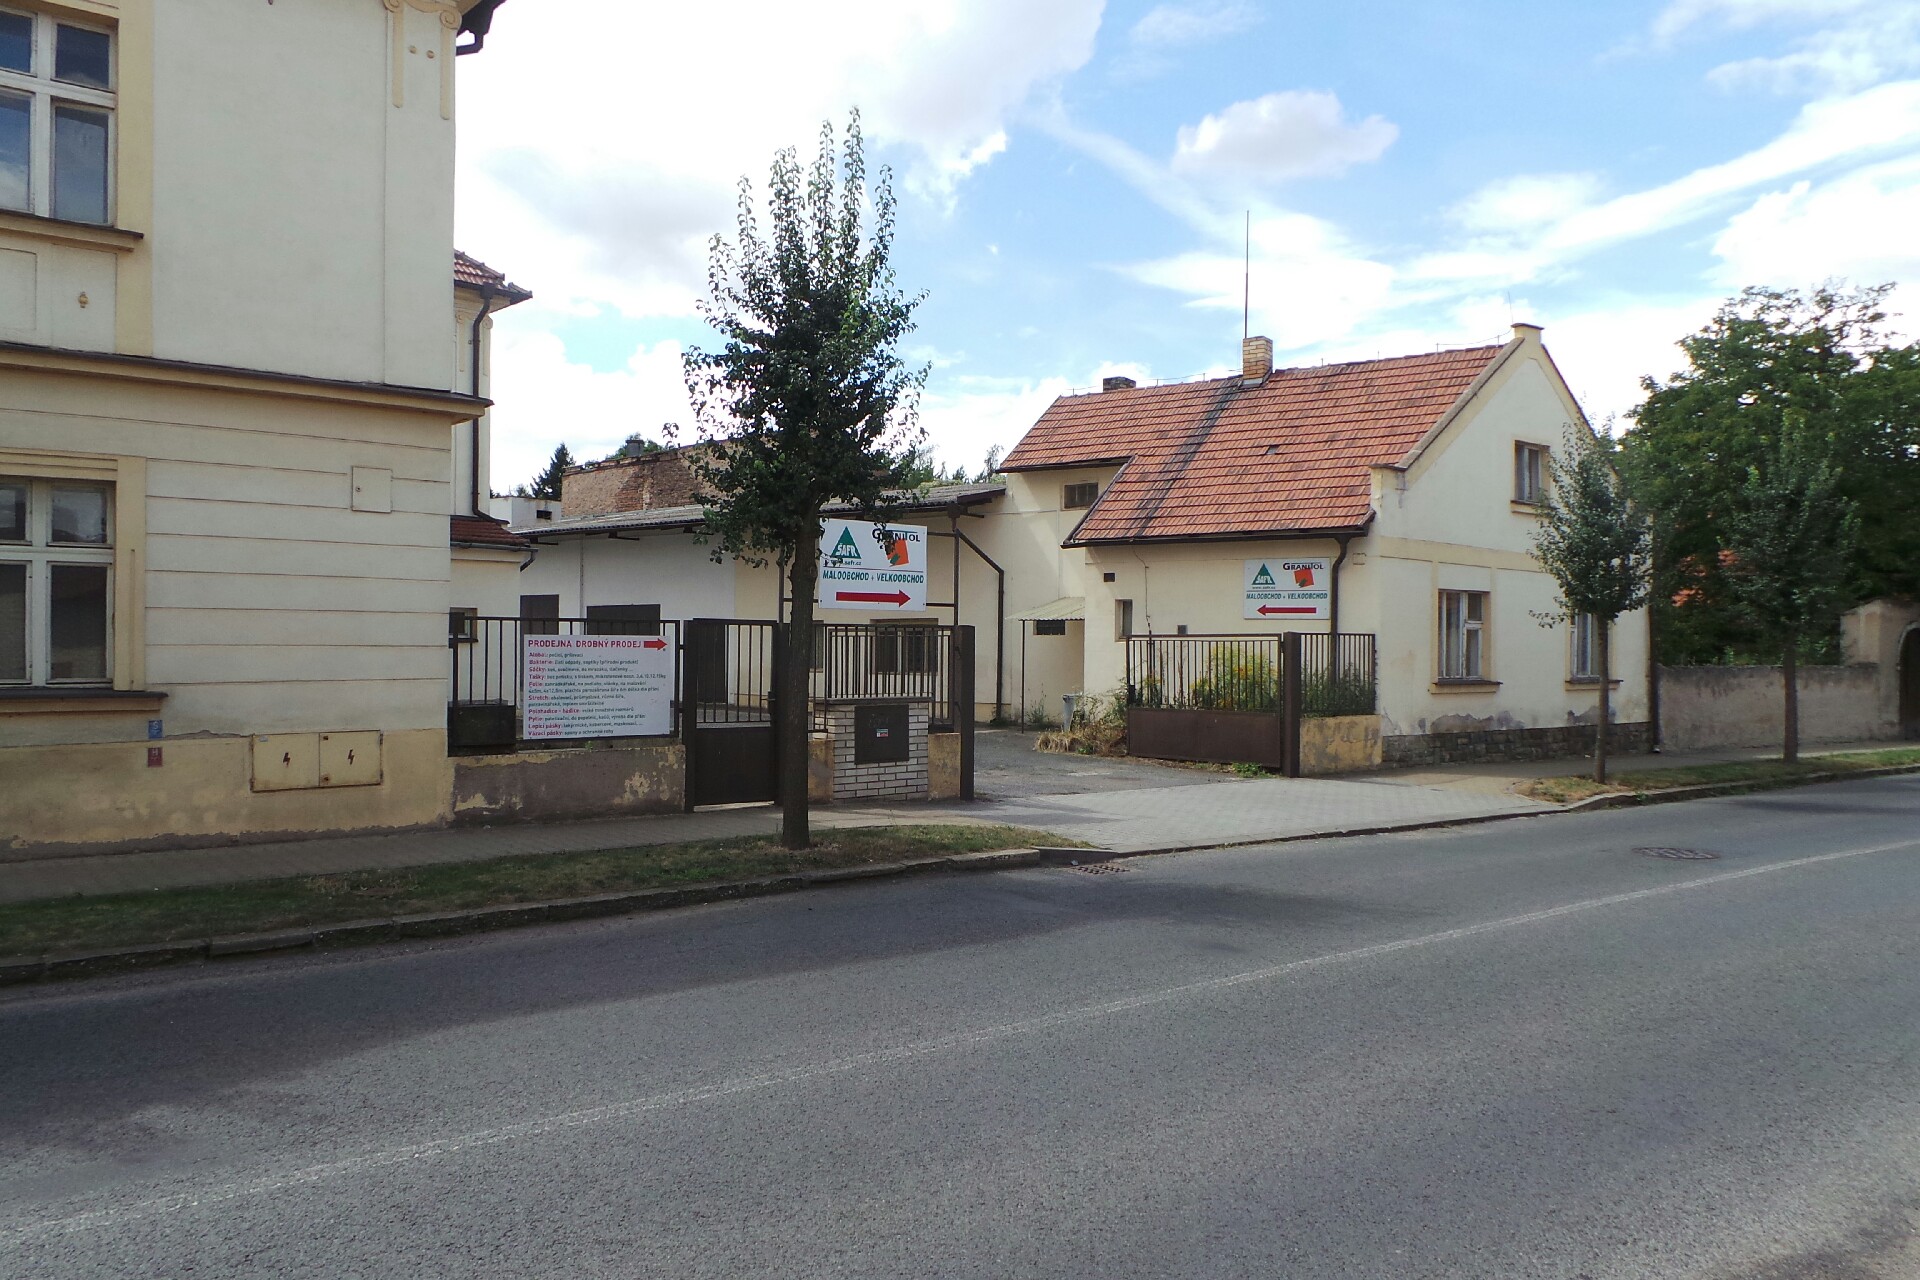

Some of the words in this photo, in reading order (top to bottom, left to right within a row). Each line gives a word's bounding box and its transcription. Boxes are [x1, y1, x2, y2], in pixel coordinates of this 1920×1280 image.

[872, 528, 920, 542] GNITOL
[835, 543, 857, 557] ŠAFR
[1282, 562, 1324, 571] GRANITOL
[823, 570, 869, 581] MALOOBCHOD
[876, 572, 924, 584] VELKOOBCHOD
[1246, 592, 1281, 600] MALOOBCHOD
[1287, 592, 1328, 600] VELKOOBCHOD
[528, 640, 572, 648] PRODEJNA
[575, 638, 609, 648] DROBNÝ
[611, 640, 641, 648] PRODEJ
